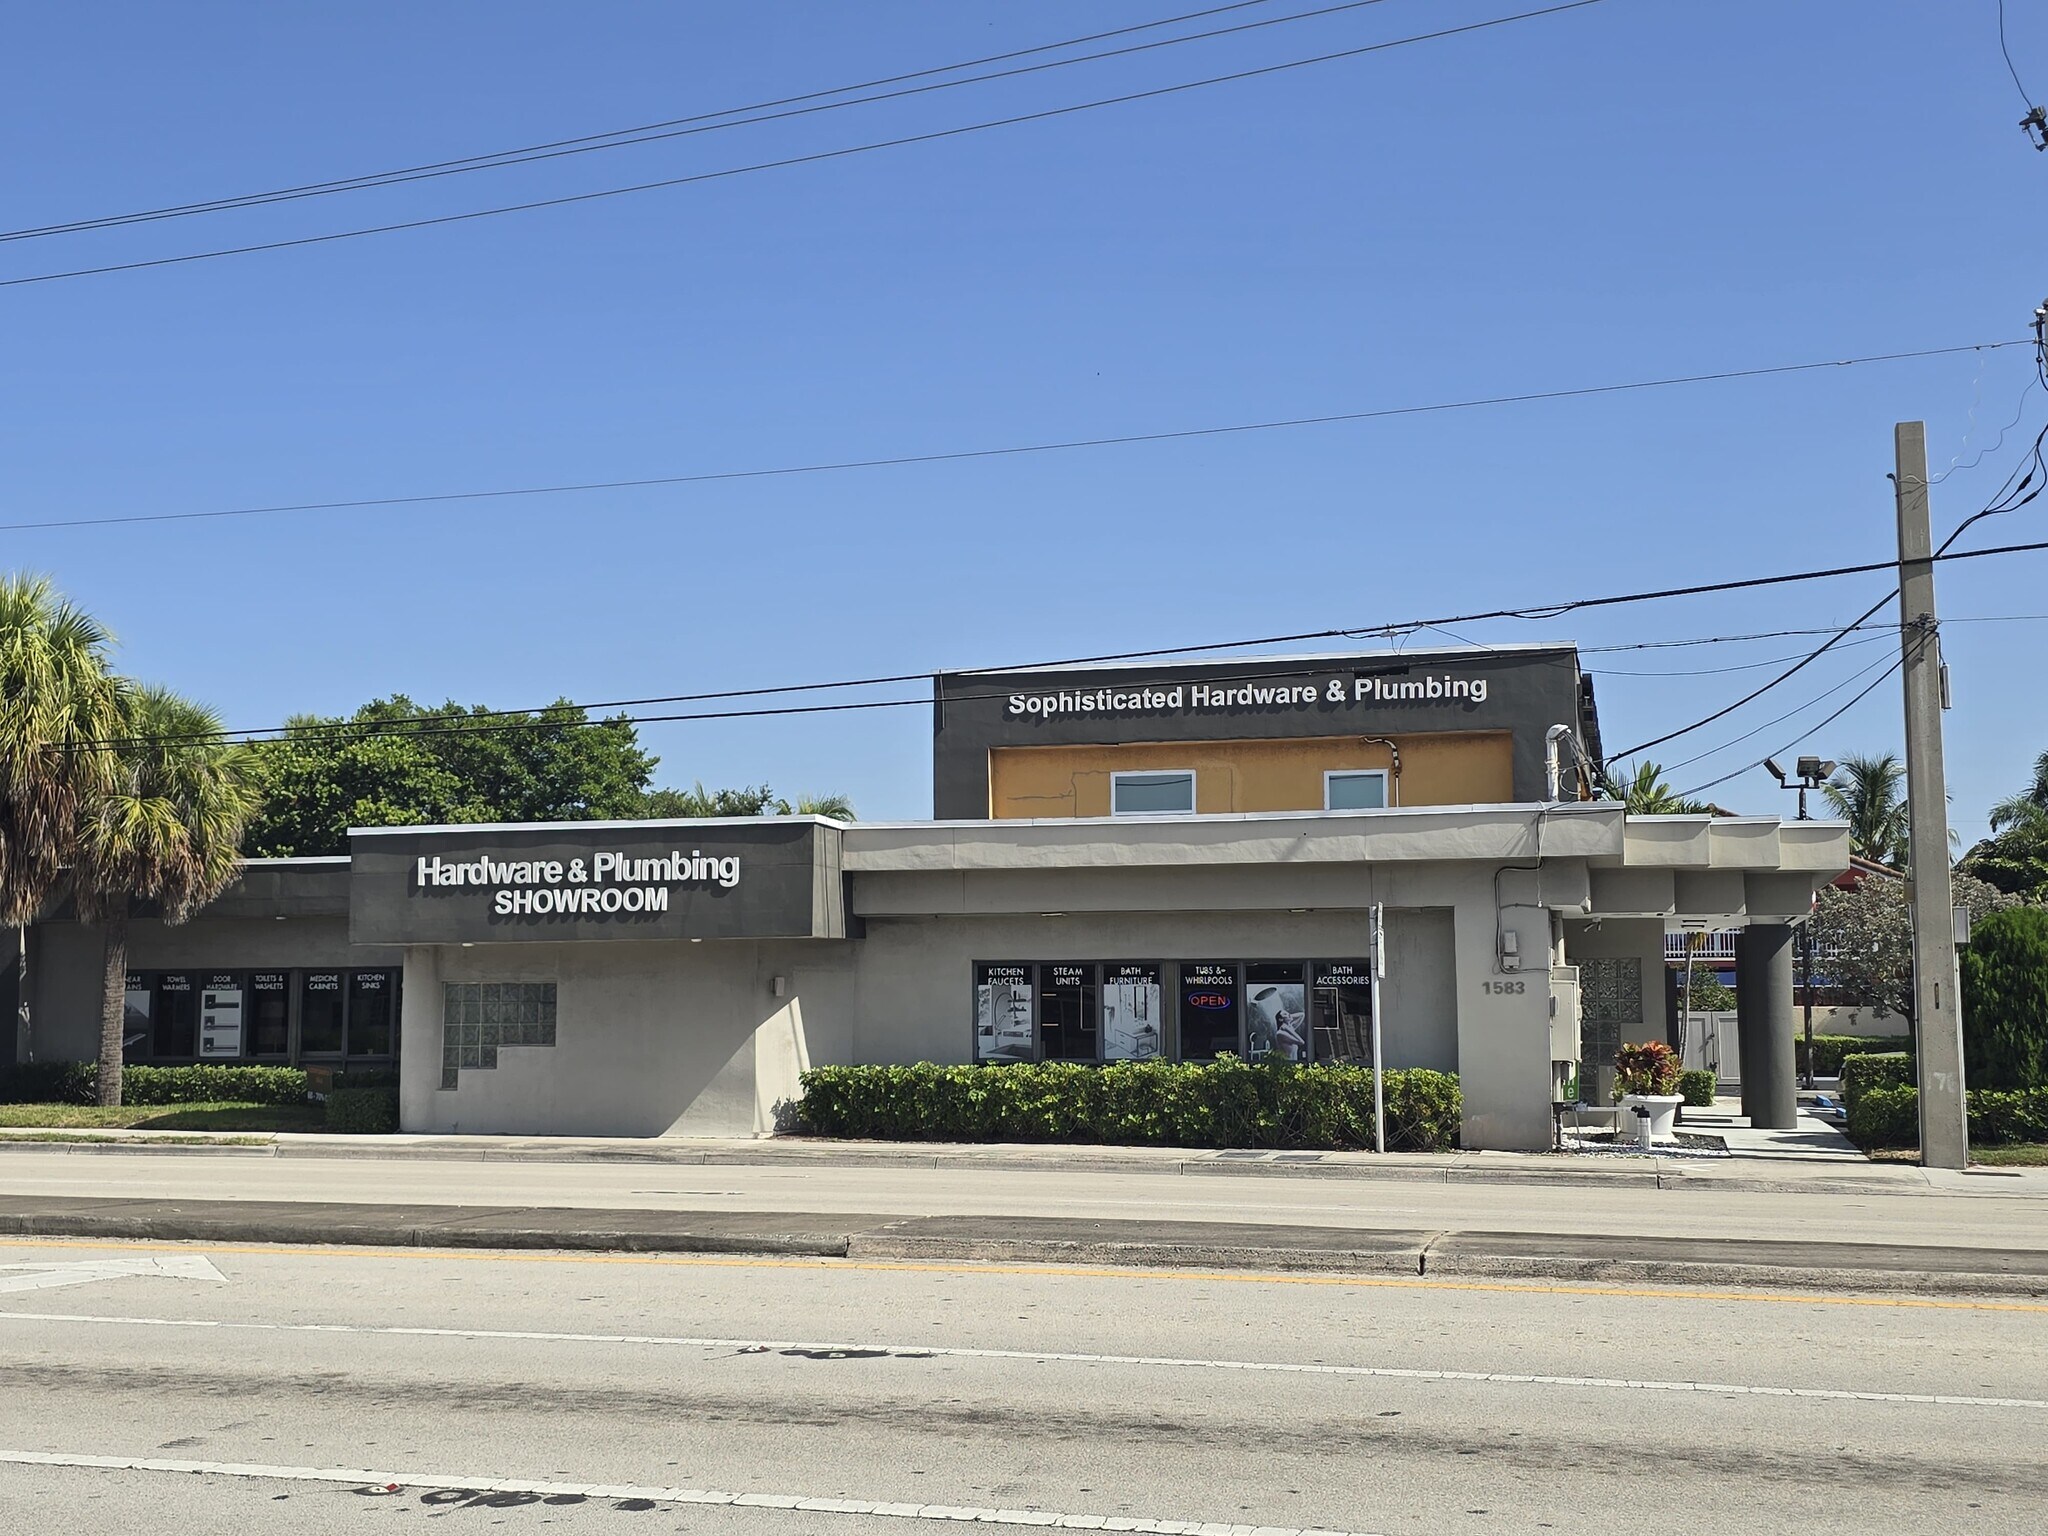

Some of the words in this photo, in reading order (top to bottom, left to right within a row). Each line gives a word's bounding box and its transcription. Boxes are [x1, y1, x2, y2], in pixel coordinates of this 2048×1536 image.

[1008, 685, 1182, 718] Sophisticated
[1190, 682, 1317, 708] Hardware
[1326, 679, 1346, 702] &
[1354, 675, 1487, 702] Plumbing
[417, 855, 563, 886] Hardware
[567, 858, 588, 884] &
[593, 849, 740, 888] Plumbing
[494, 886, 668, 915] SHOWROOM
[988, 968, 1024, 976] KITCHEN
[1053, 967, 1083, 976] STEAM
[1120, 967, 1142, 976] BATH
[1195, 966, 1214, 975] TUBS
[1332, 966, 1353, 975] BATH
[213, 975, 231, 983] DOOR
[309, 974, 338, 982] MEDICINE
[987, 977, 1024, 985] FAUCETS
[1056, 977, 1081, 985] UNITS
[1109, 976, 1153, 985] FURNITURE
[1185, 976, 1233, 985] WHIRLPOOLS
[1316, 976, 1370, 985] ACCESSORIES
[308, 982, 339, 990] CABINETS
[1482, 981, 1525, 995] 1583
[1191, 995, 1227, 1006] OPEN
